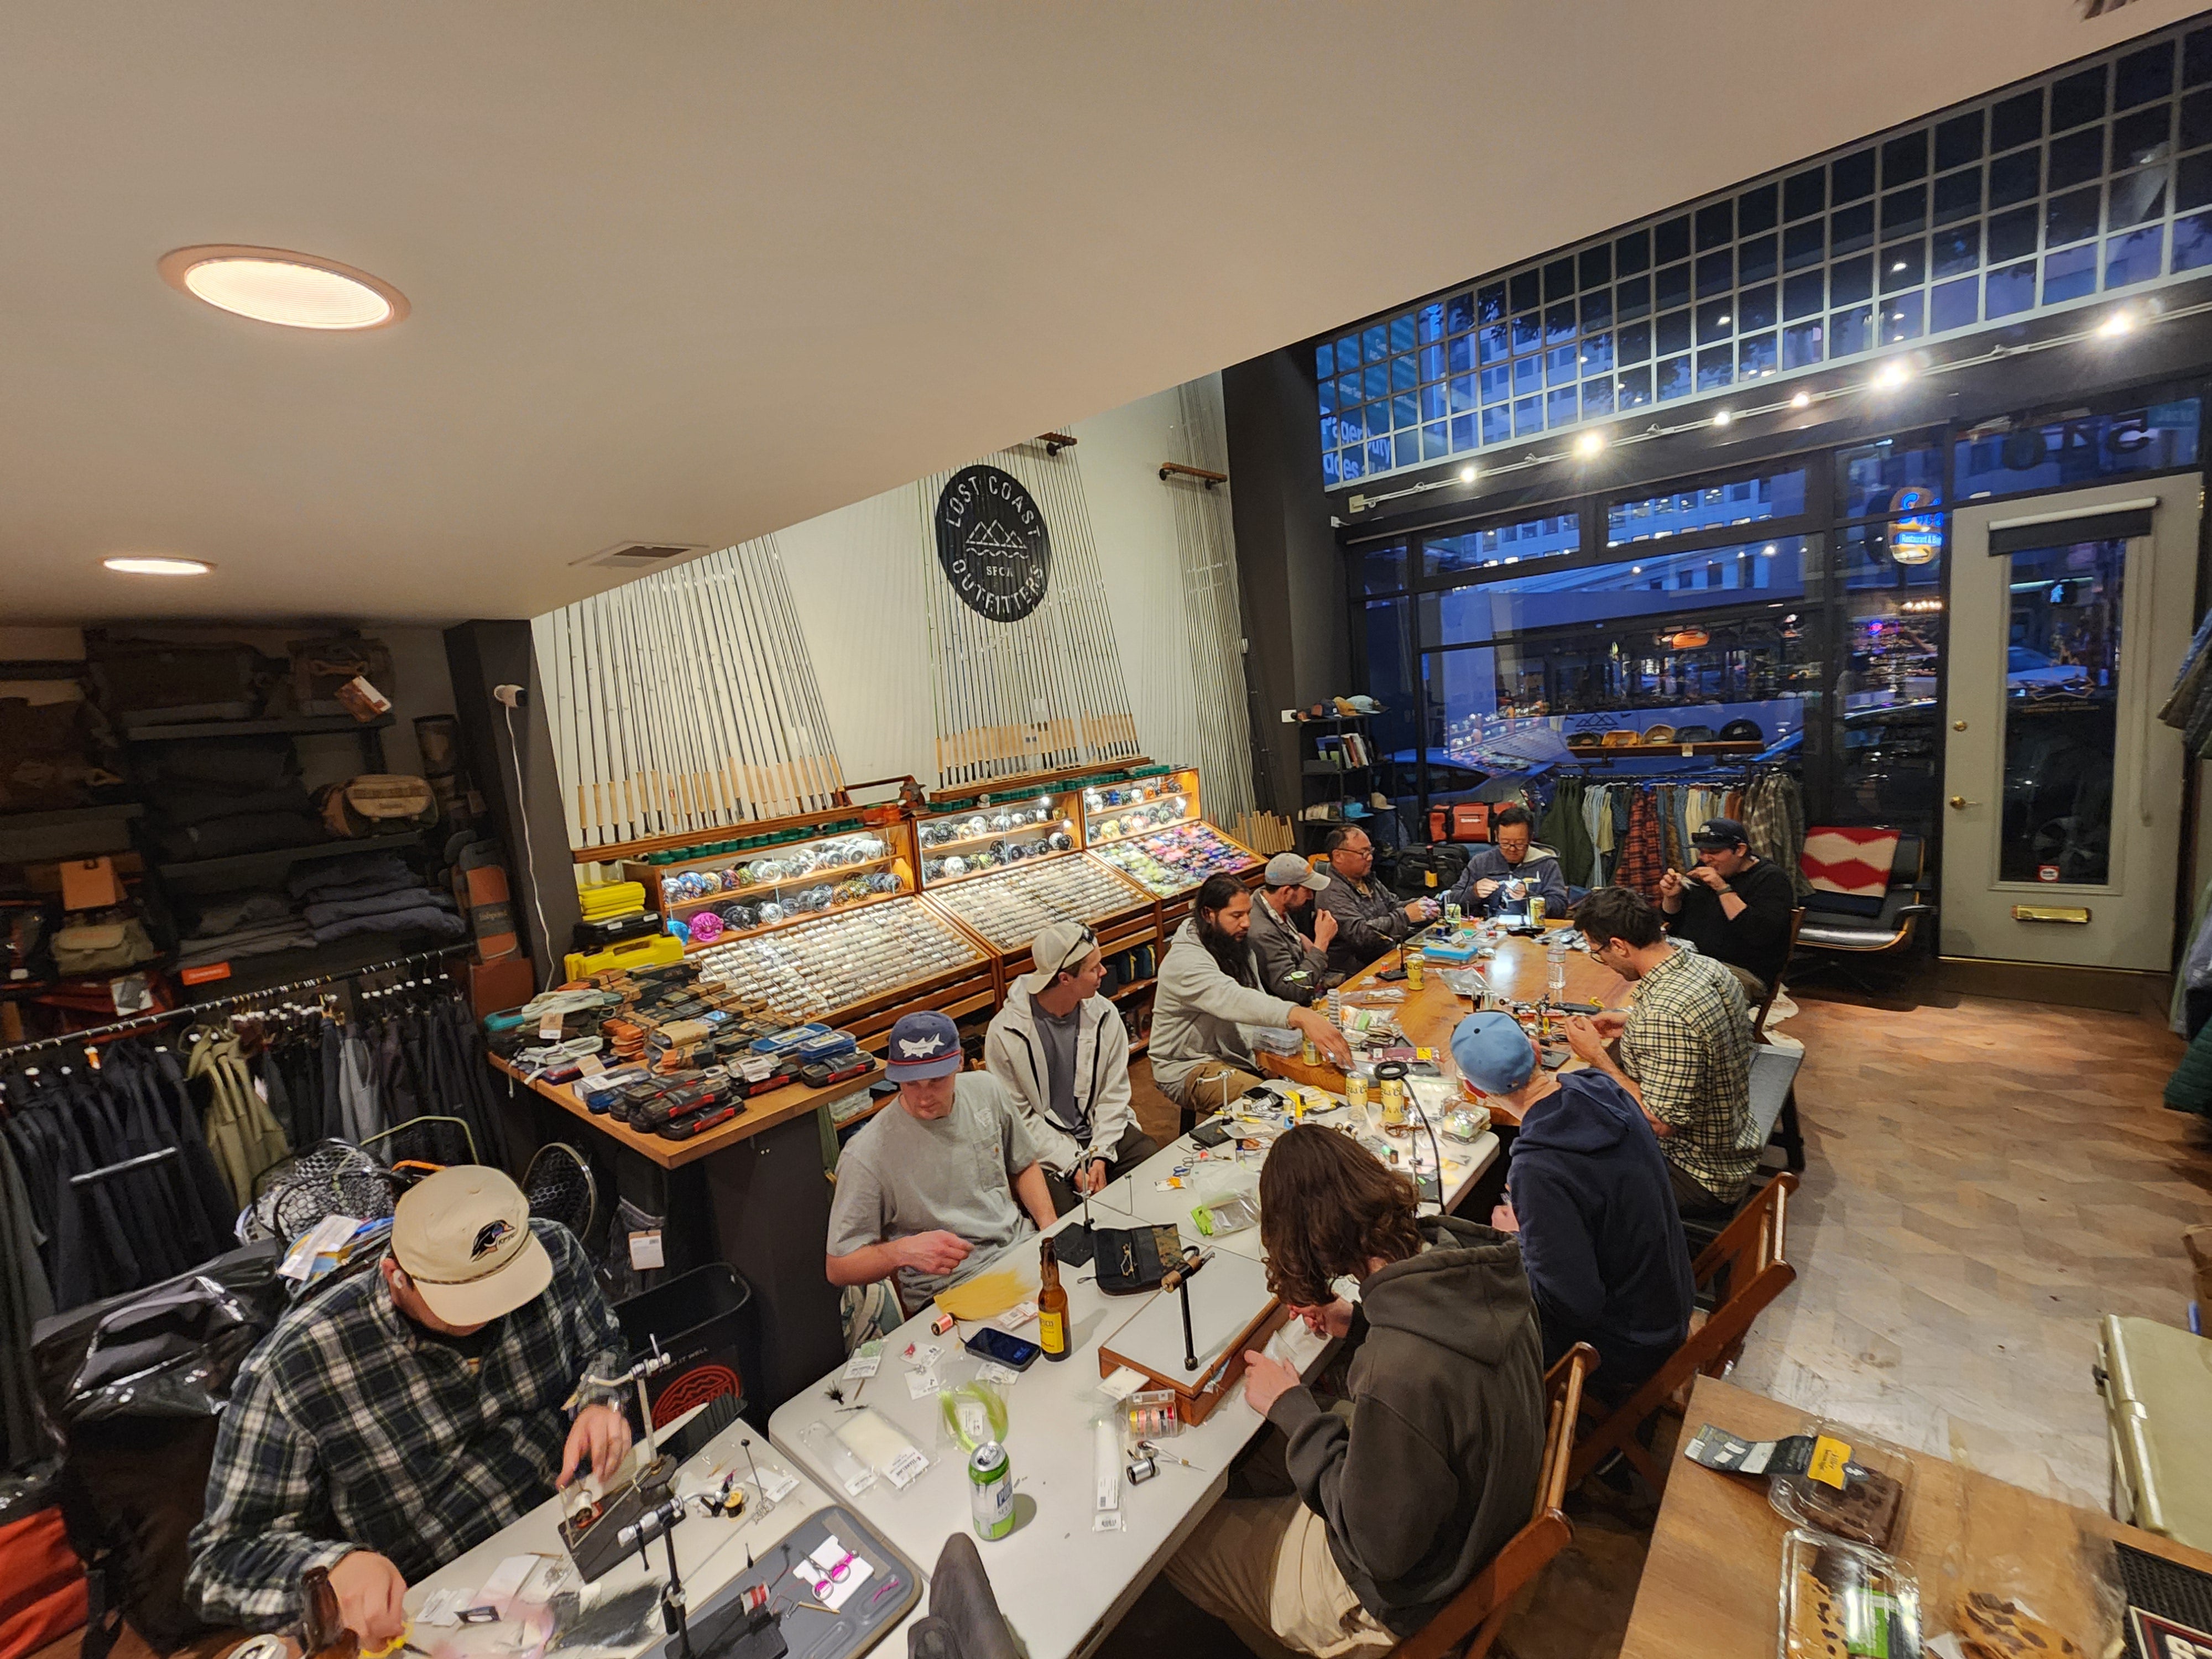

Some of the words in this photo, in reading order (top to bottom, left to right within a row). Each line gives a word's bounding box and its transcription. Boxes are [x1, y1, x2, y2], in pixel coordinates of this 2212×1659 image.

[946, 476, 979, 527] LOST
[988, 476, 1041, 537] COAST
[1902, 534, 1927, 544] Restaurant
[952, 559, 1042, 615] OUTFITTERS
